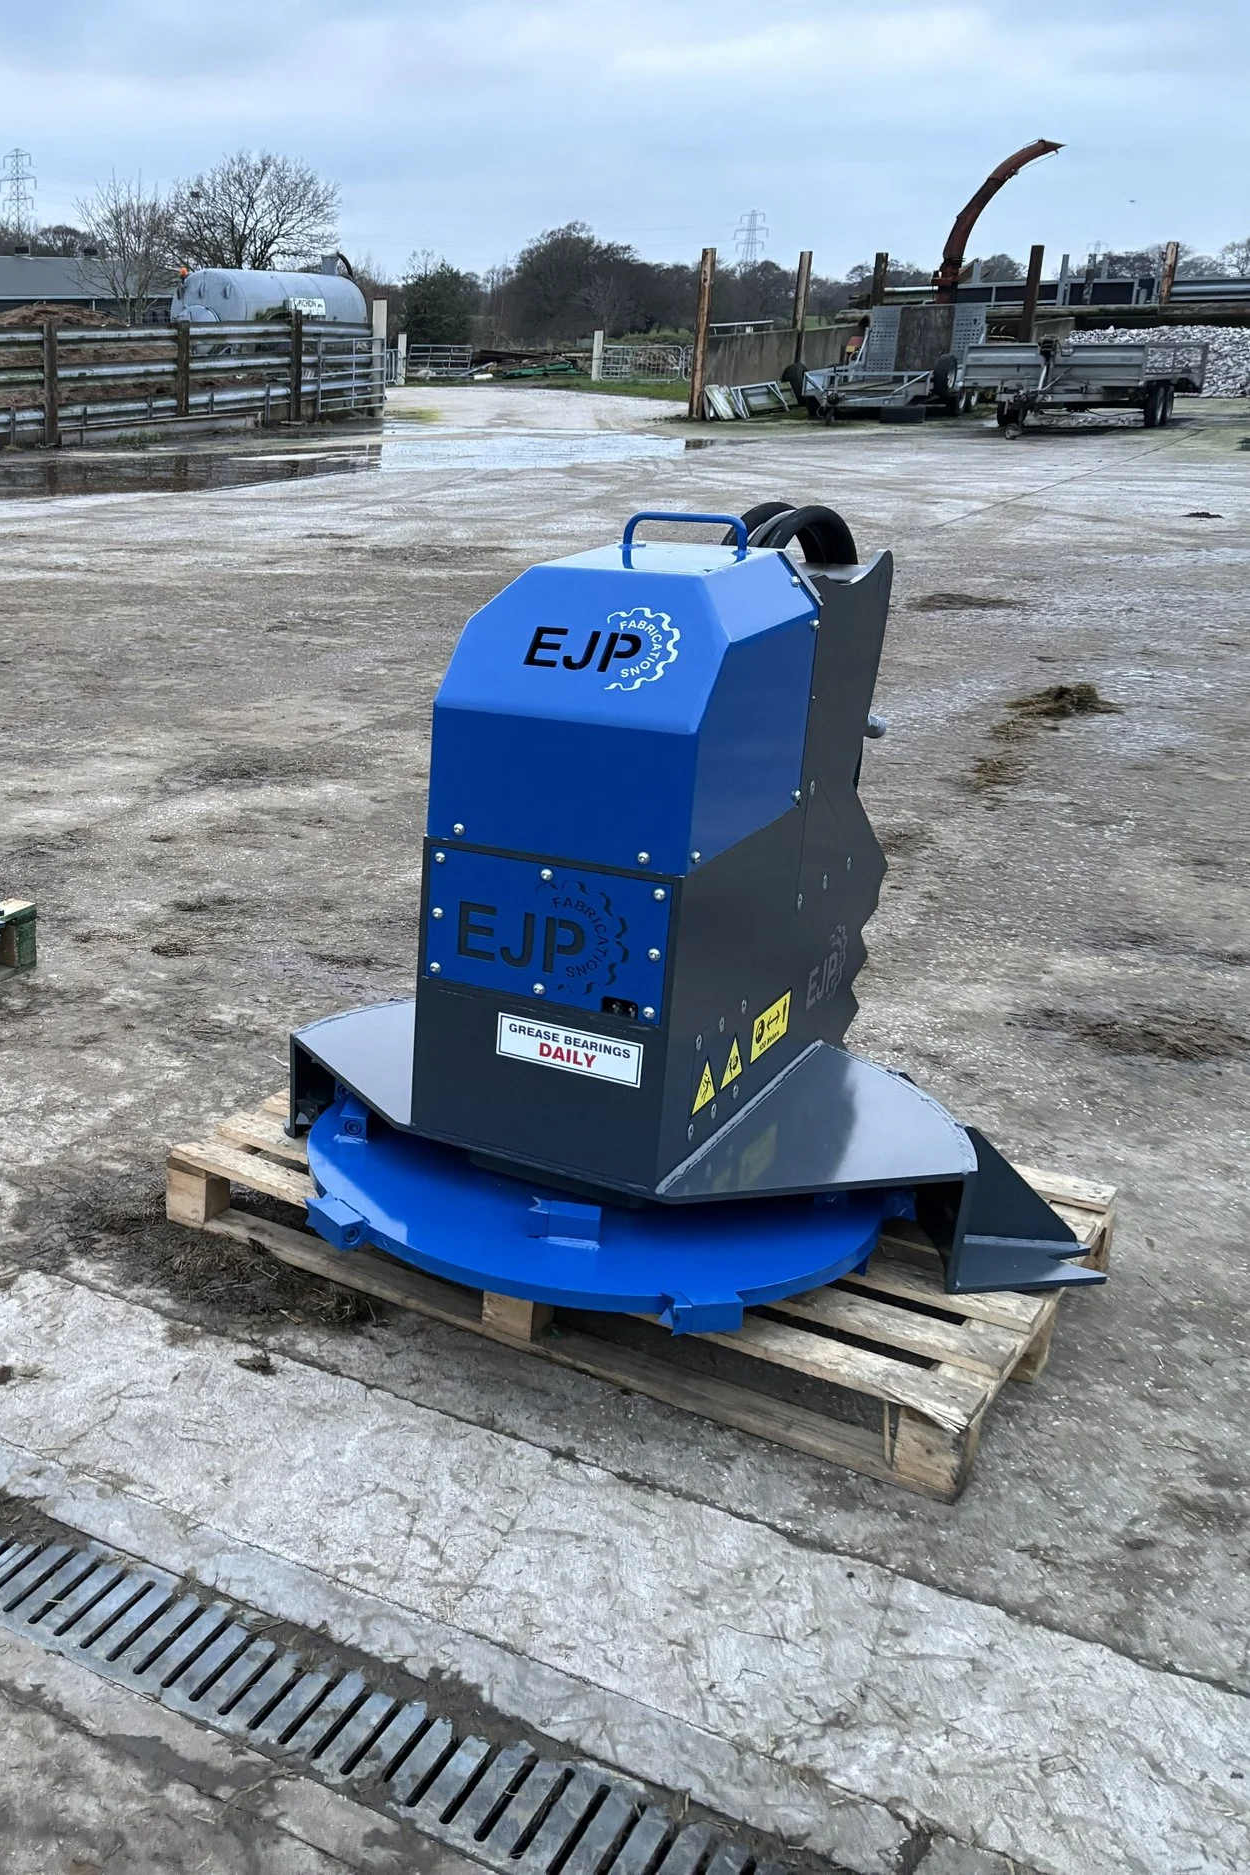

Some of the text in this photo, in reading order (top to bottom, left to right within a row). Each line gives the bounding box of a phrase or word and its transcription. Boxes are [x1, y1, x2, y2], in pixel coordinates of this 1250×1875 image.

[522, 626, 642, 673] EJP
[618, 619, 664, 678] FABRICATIONS
[456, 900, 585, 975] EJP
[551, 896, 610, 979] FABRICATIONS
[806, 951, 838, 1010] EJP
[508, 1022, 631, 1059] GREASE BEARINGS
[538, 1041, 597, 1069] DAILY
